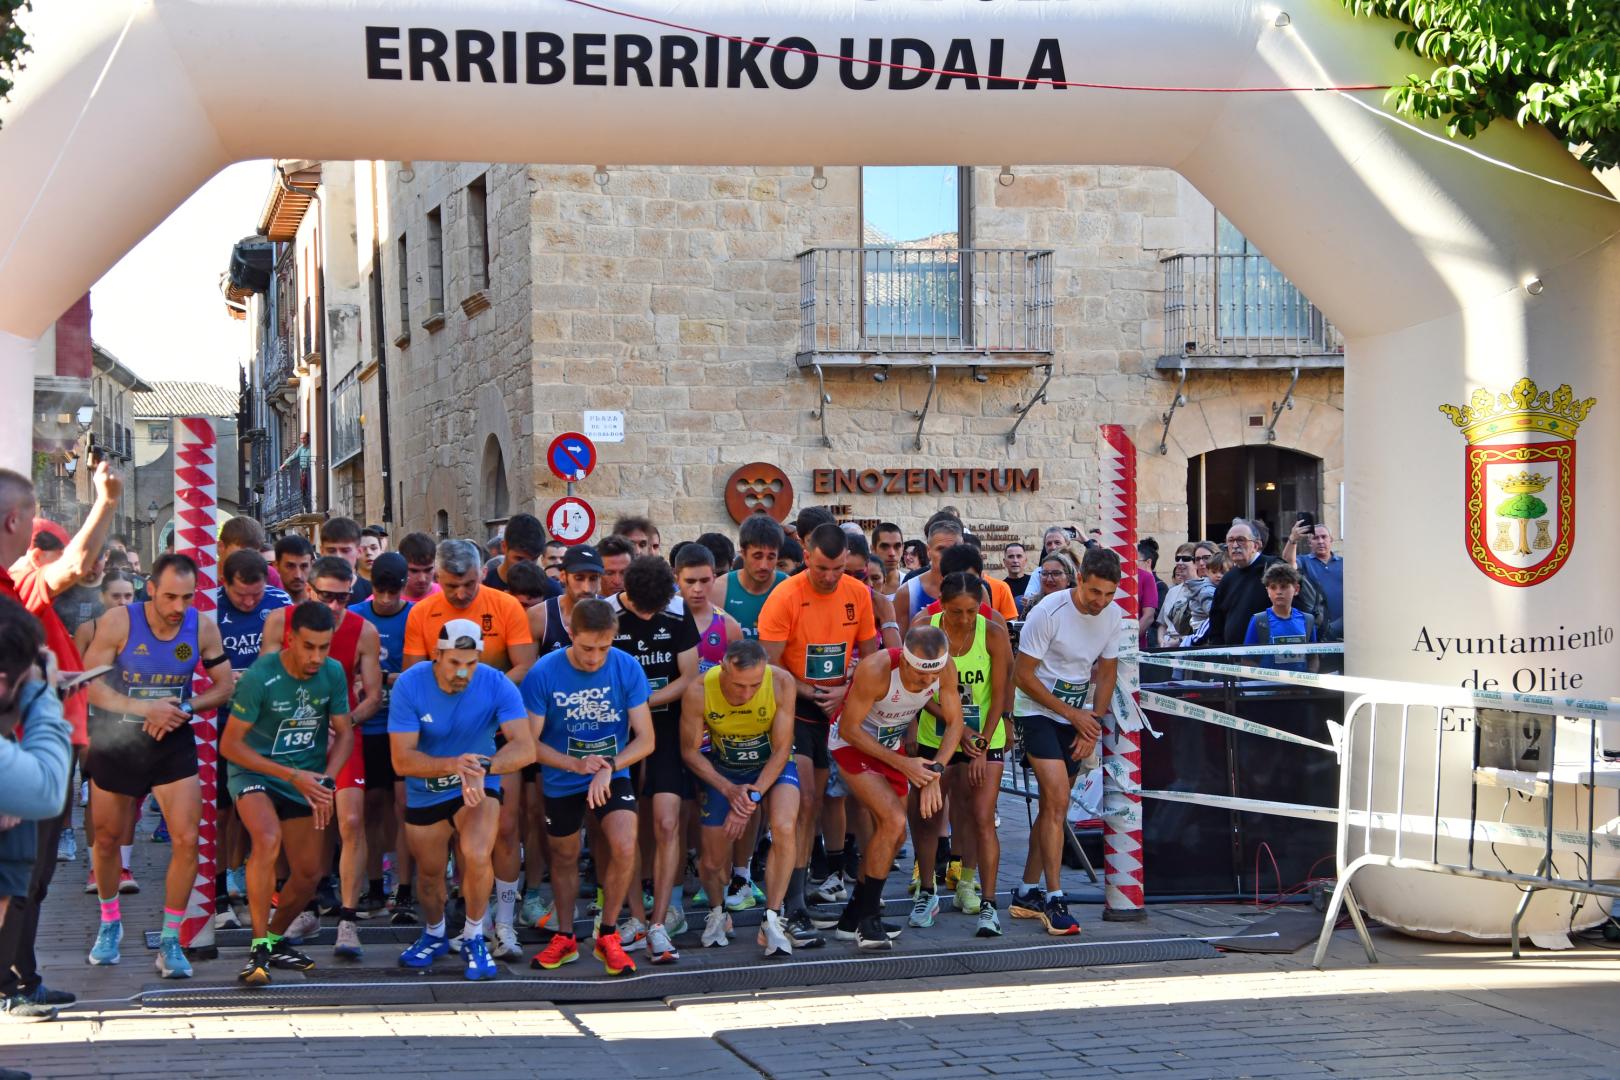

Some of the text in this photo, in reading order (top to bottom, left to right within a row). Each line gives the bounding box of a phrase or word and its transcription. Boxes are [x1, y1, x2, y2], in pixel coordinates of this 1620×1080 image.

[365, 26, 1068, 91] ERRIBERRIKO UDALA
[813, 468, 1040, 493] ENOZENTRUM
[978, 523, 1009, 531] Cultura
[1412, 625, 1614, 661] Ayuntamiento
[823, 660, 833, 673] 9
[1461, 667, 1583, 693] de Olite
[283, 732, 313, 747] 139
[736, 751, 759, 760] 28
